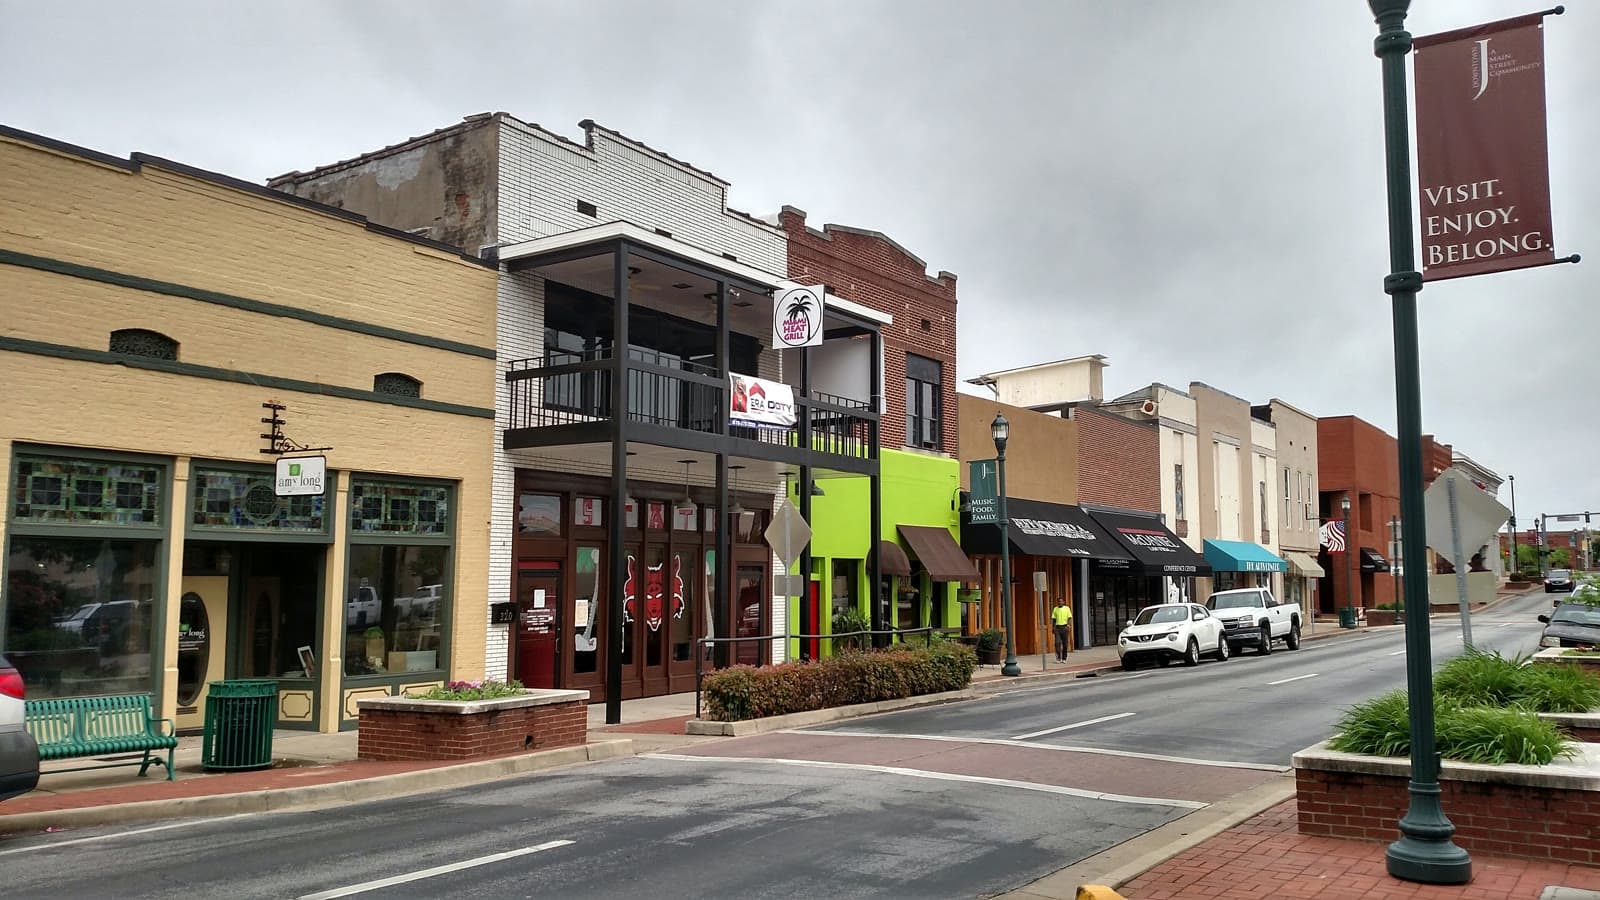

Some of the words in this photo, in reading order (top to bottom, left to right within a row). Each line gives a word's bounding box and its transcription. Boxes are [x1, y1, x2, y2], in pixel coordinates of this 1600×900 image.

[1489, 53, 1511, 63] MAIN
[1489, 59, 1516, 69] STREET
[1472, 38, 1492, 100] J
[1489, 61, 1541, 77] COMMUNITY
[1423, 178, 1504, 208] VISIT.
[1426, 205, 1519, 237] ENJOY.
[1427, 231, 1550, 266] BELONG.
[783, 317, 807, 326] MIAMI
[783, 324, 806, 334] HEAT
[784, 332, 805, 341] GRILL
[750, 397, 765, 409] ERA
[767, 400, 792, 413] DOTY
[300, 470, 322, 491] long
[971, 498, 996, 506] MUSIC.
[972, 513, 998, 521] FAMILY.
